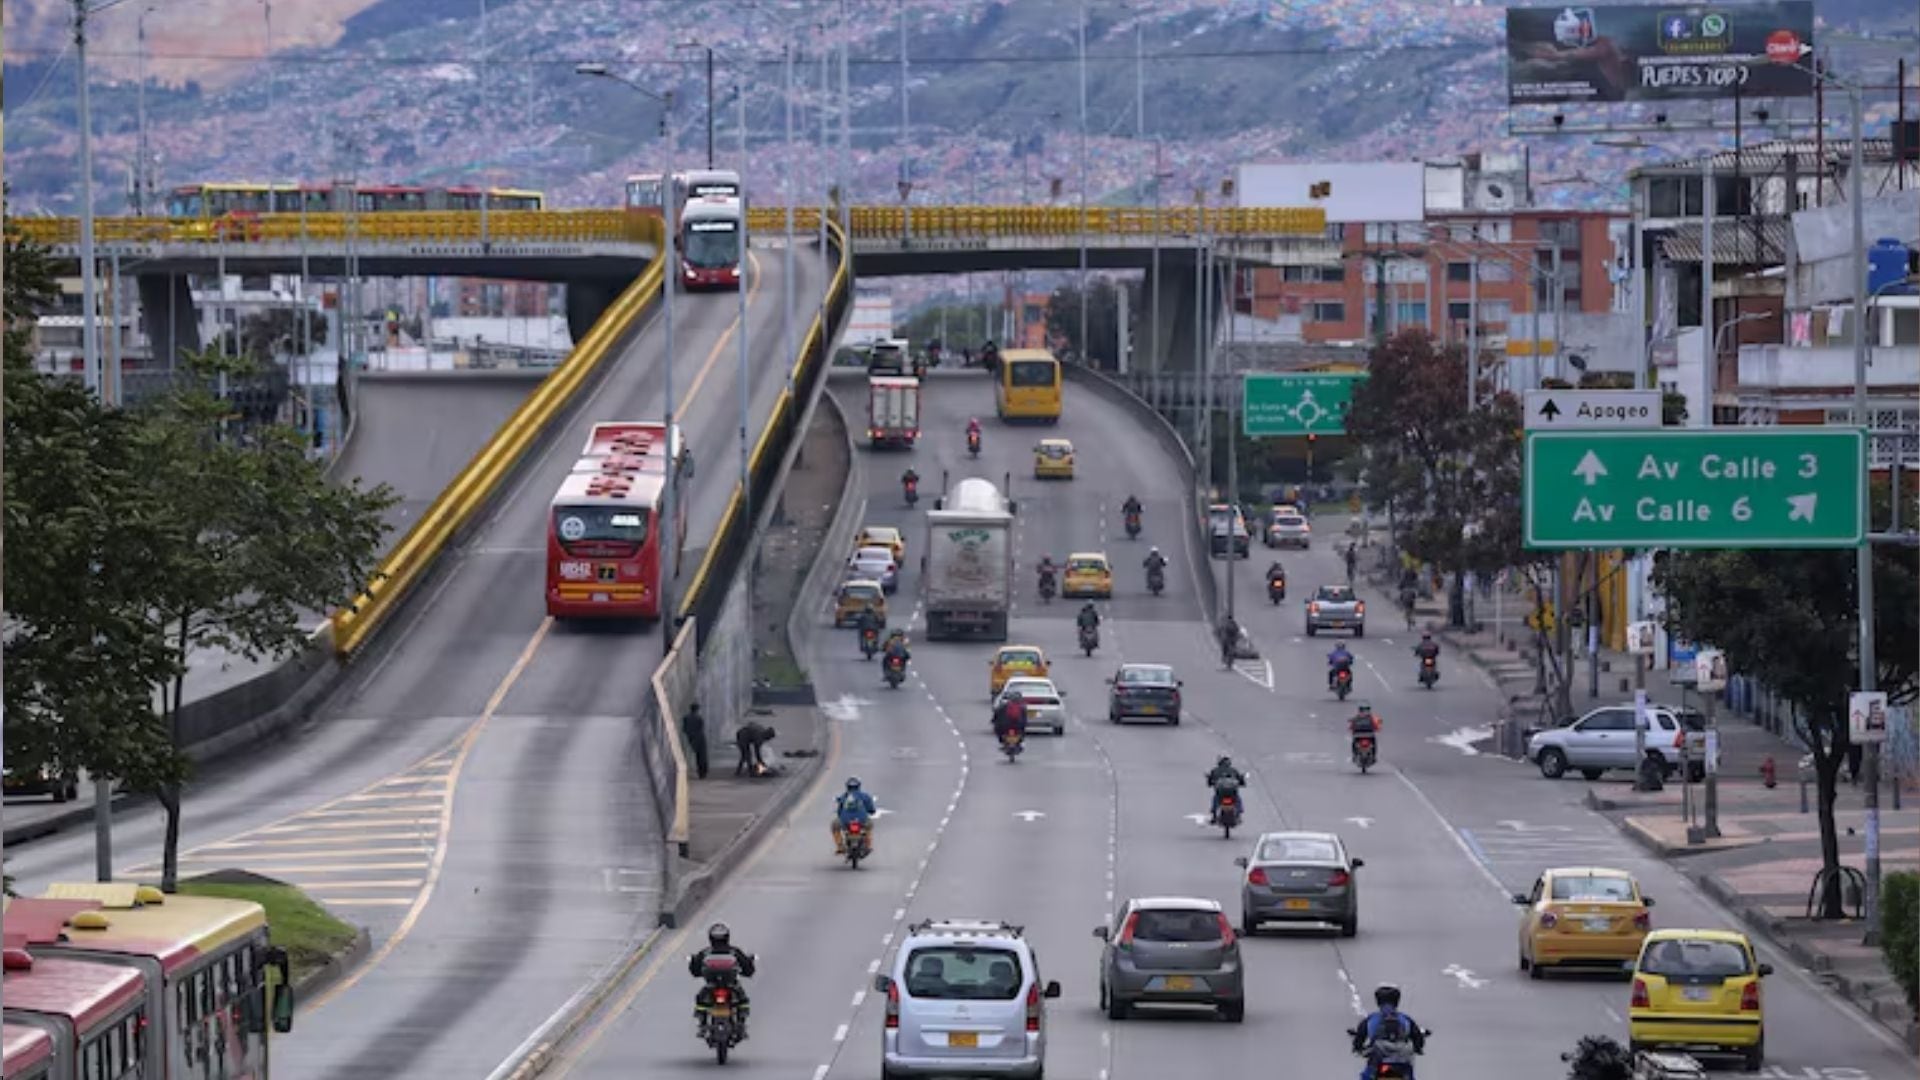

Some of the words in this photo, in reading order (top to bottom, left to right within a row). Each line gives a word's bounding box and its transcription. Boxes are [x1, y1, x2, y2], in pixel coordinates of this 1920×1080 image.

[1576, 401, 1649, 420] Apogeo
[1638, 454, 1679, 479] Av
[1700, 454, 1776, 479] Calle
[1798, 454, 1818, 478] 3
[1573, 498, 1614, 521] Av
[1636, 497, 1711, 521] Calle
[1732, 497, 1752, 521] 6
